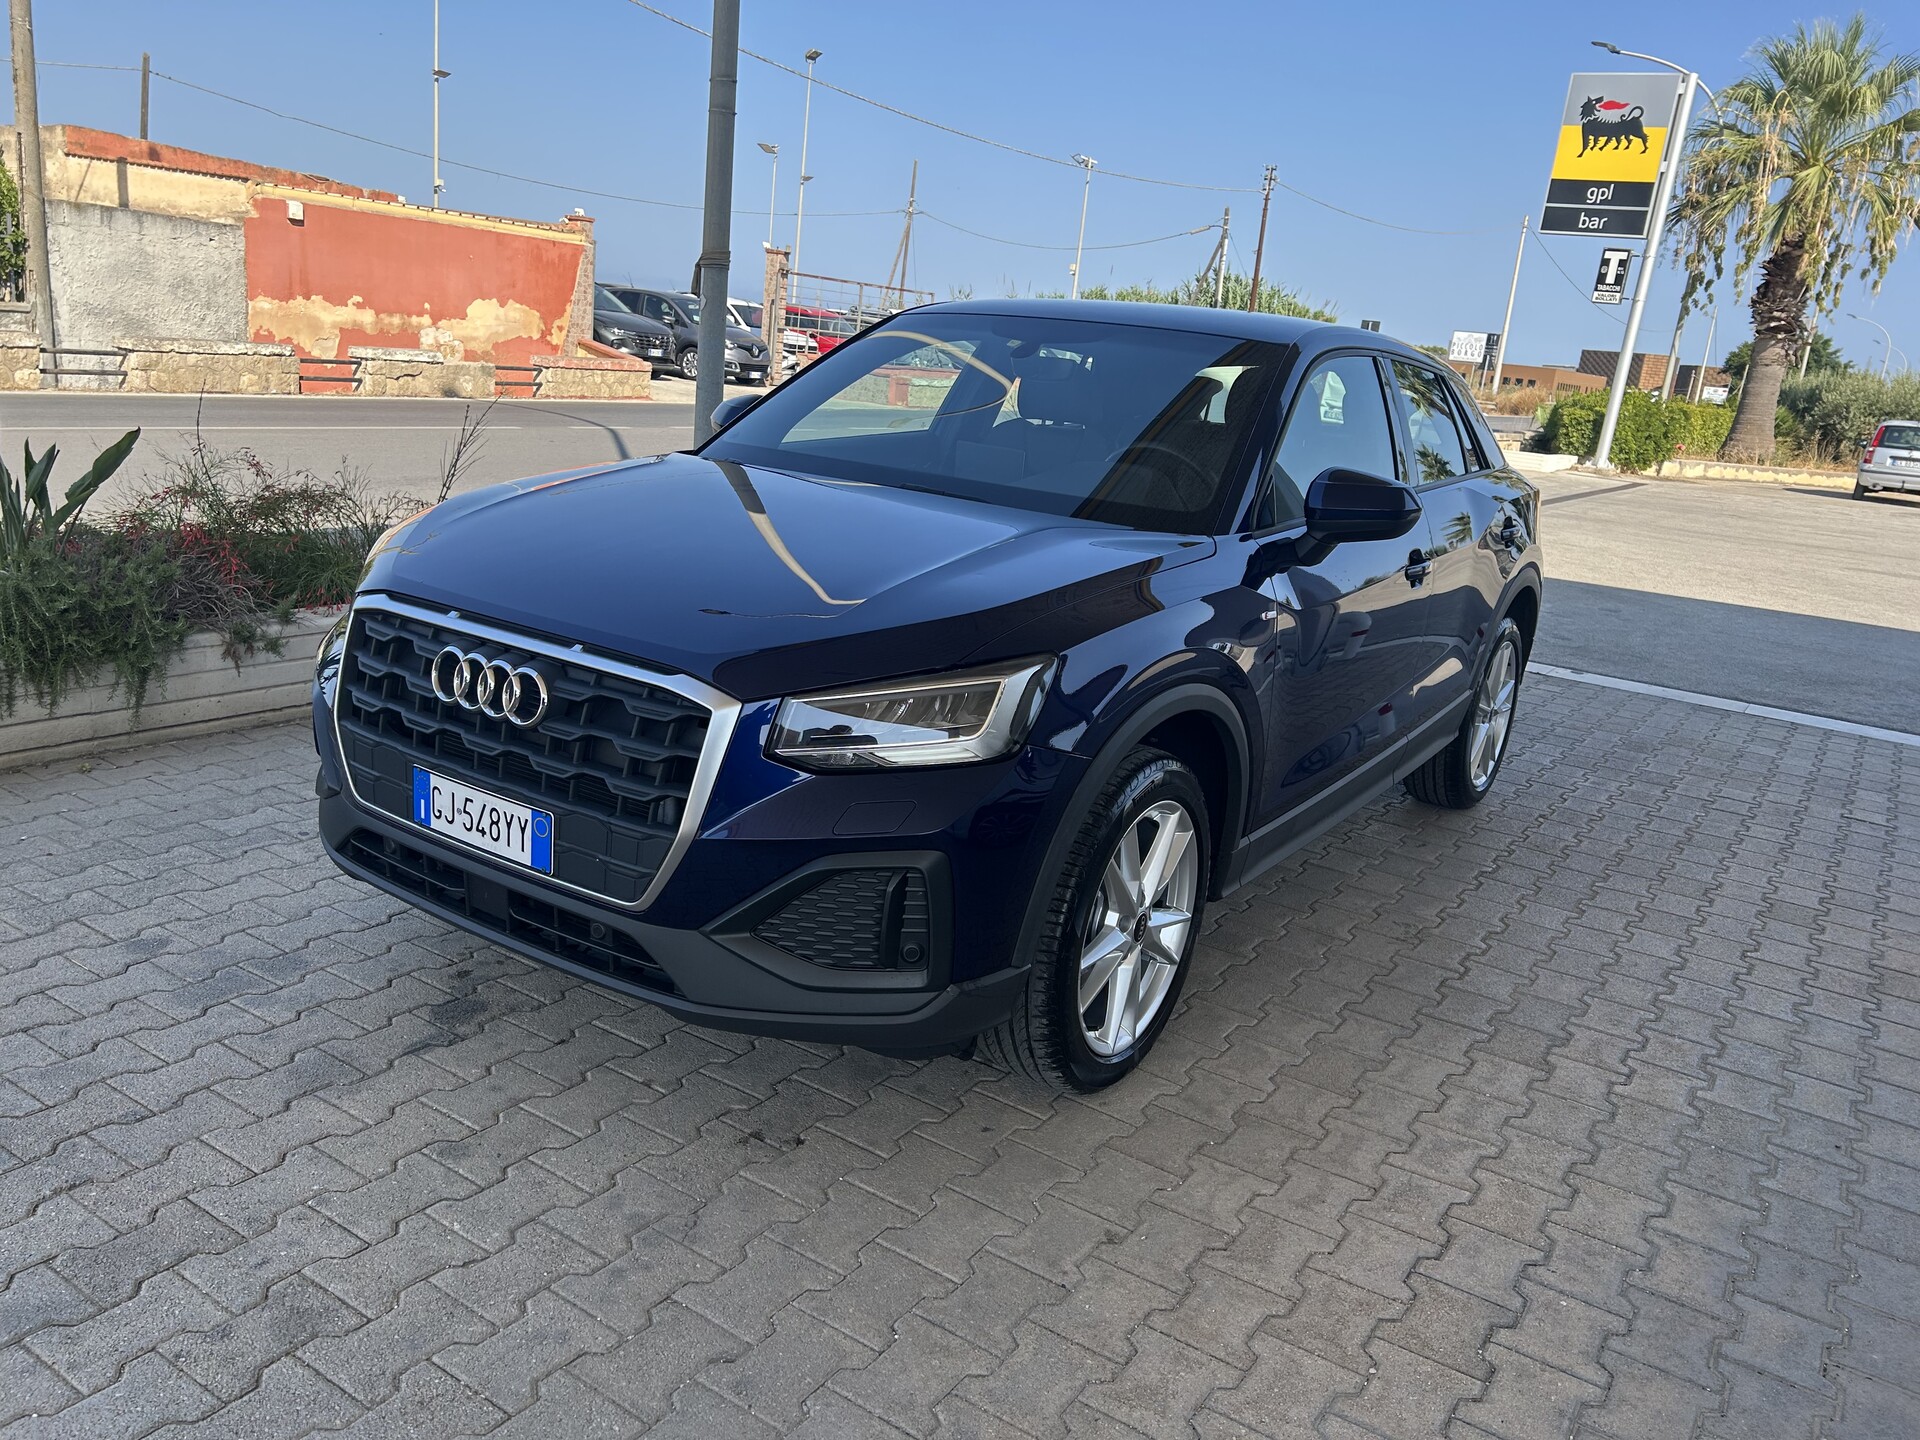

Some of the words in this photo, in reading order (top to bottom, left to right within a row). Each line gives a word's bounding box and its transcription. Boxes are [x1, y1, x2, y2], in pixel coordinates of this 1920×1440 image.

[1586, 184, 1614, 203] gpl
[1578, 212, 1608, 229] bar
[1604, 251, 1628, 284] T
[1597, 284, 1621, 292] TABACCHI
[1452, 342, 1483, 350] PICCOLO
[1451, 349, 1482, 357] BORGO
